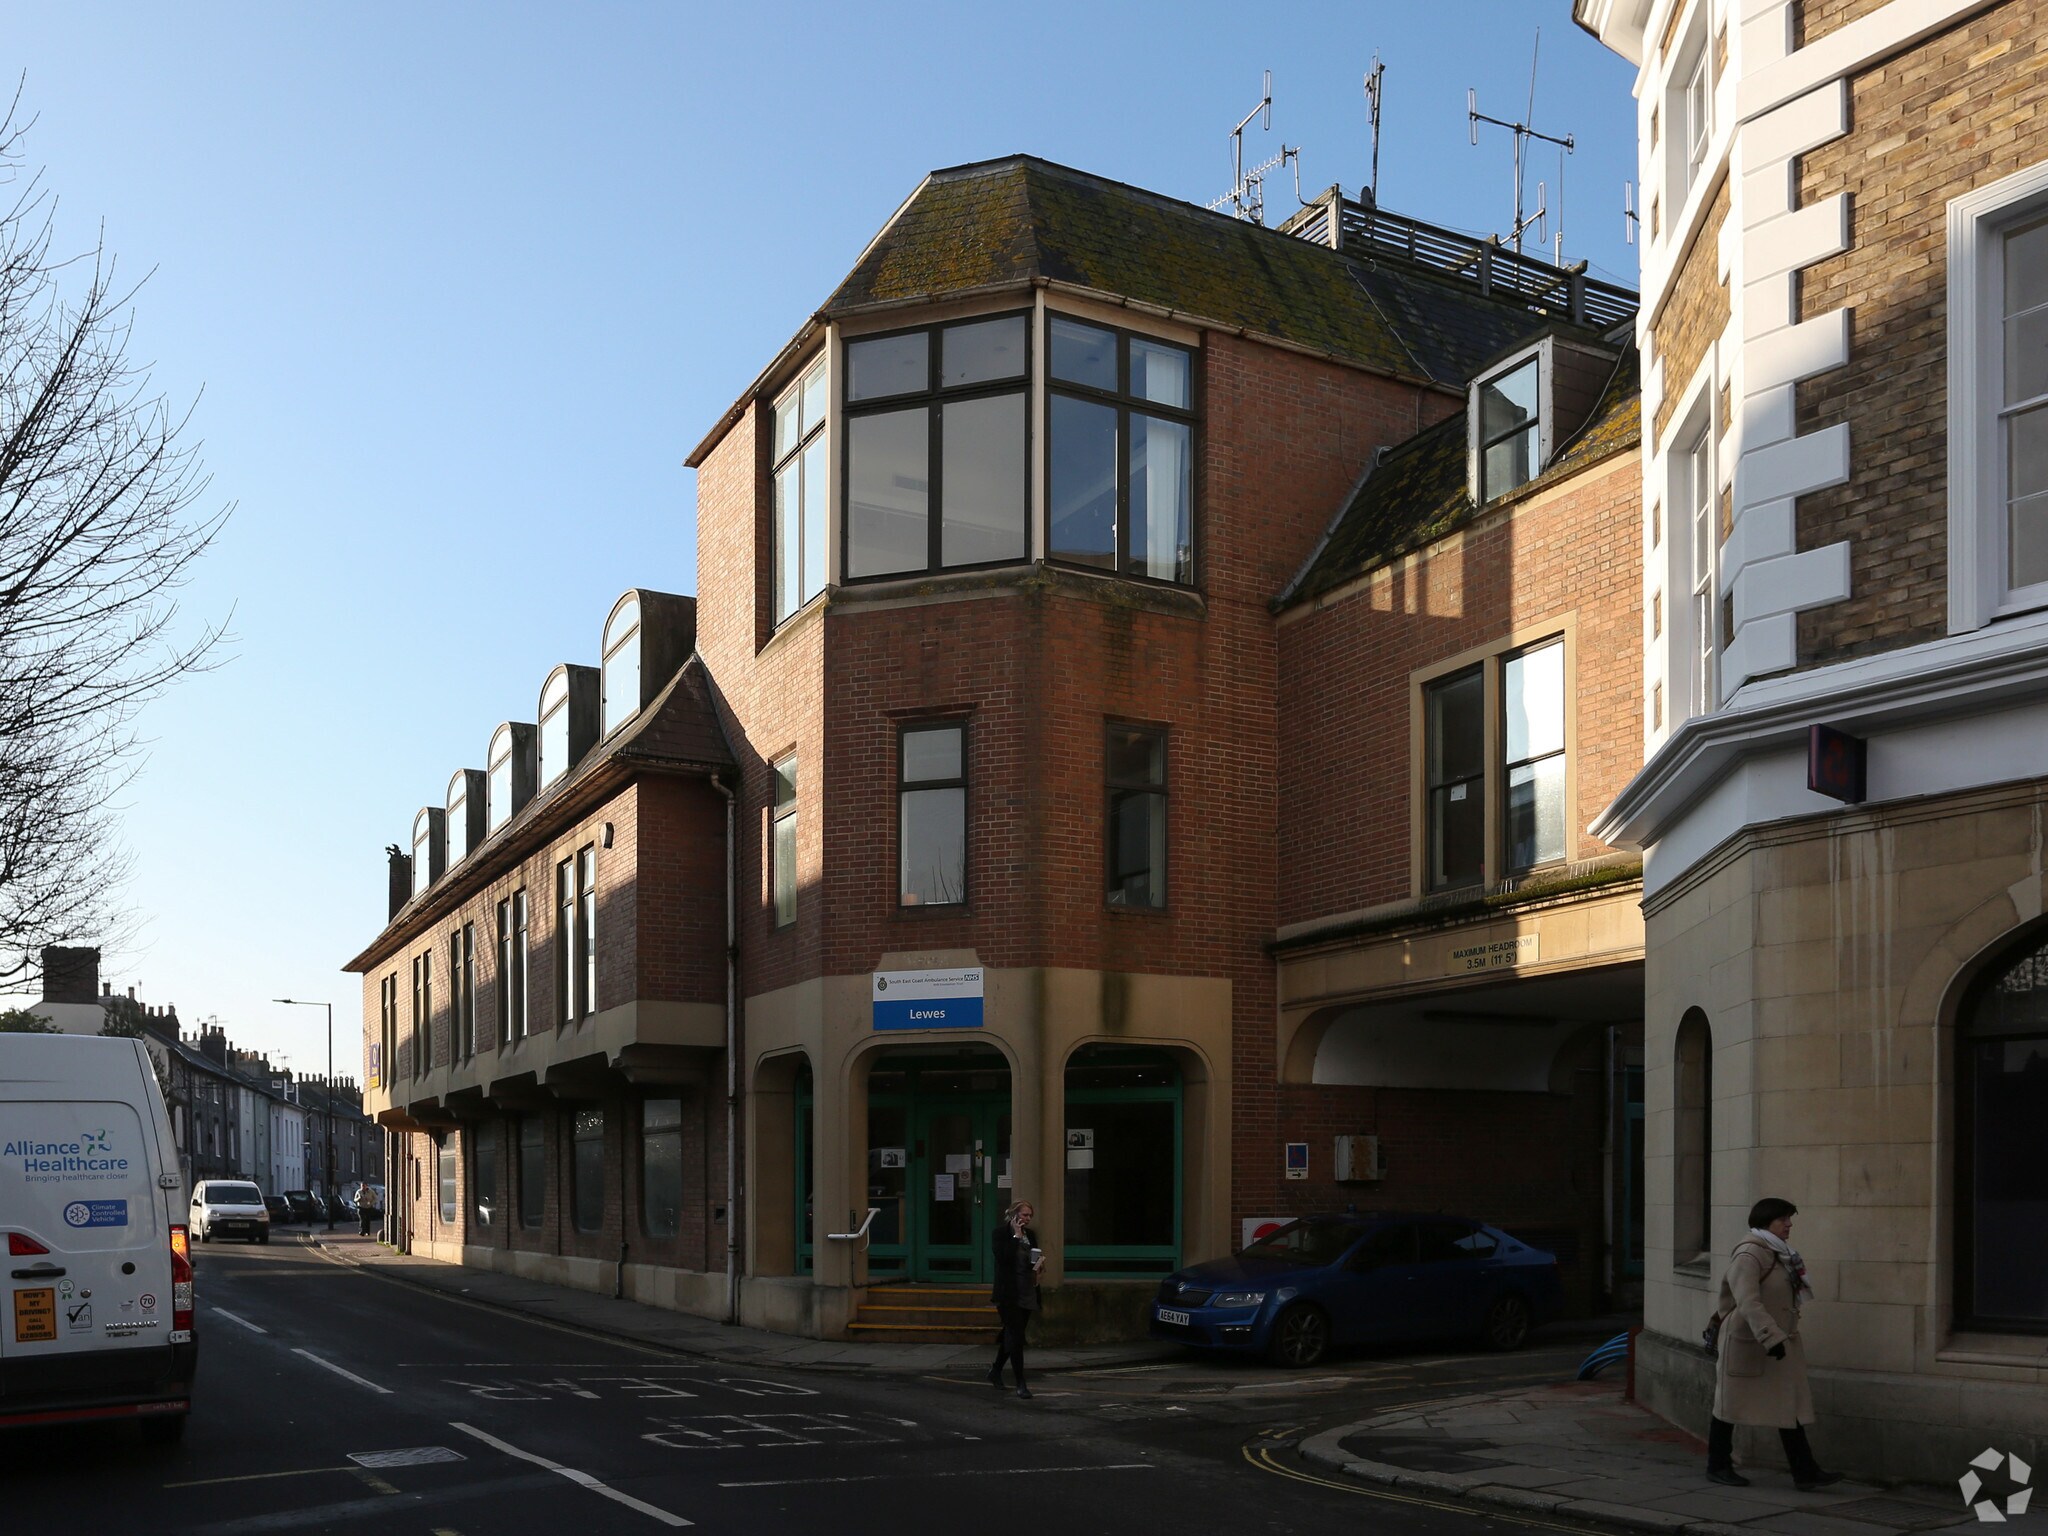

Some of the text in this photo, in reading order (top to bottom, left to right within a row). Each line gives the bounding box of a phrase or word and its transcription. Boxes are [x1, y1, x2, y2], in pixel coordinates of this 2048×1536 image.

[1453, 938, 1533, 959] MAXIMUM HEADROOM
[1467, 958, 1486, 969] 3.5M
[964, 974, 980, 982] NHS
[909, 1009, 946, 1020] Lewes
[4, 1141, 80, 1156] Alliance
[24, 1157, 128, 1173] Healthcare
[25, 1172, 128, 1183] Bringing healthcare closer
[91, 1209, 126, 1217] Controlled
[142, 1297, 153, 1305] 70
[1161, 1311, 1188, 1324] AE64 YAY
[105, 1320, 159, 1330] RENAULT
[105, 1330, 138, 1338] TECH
